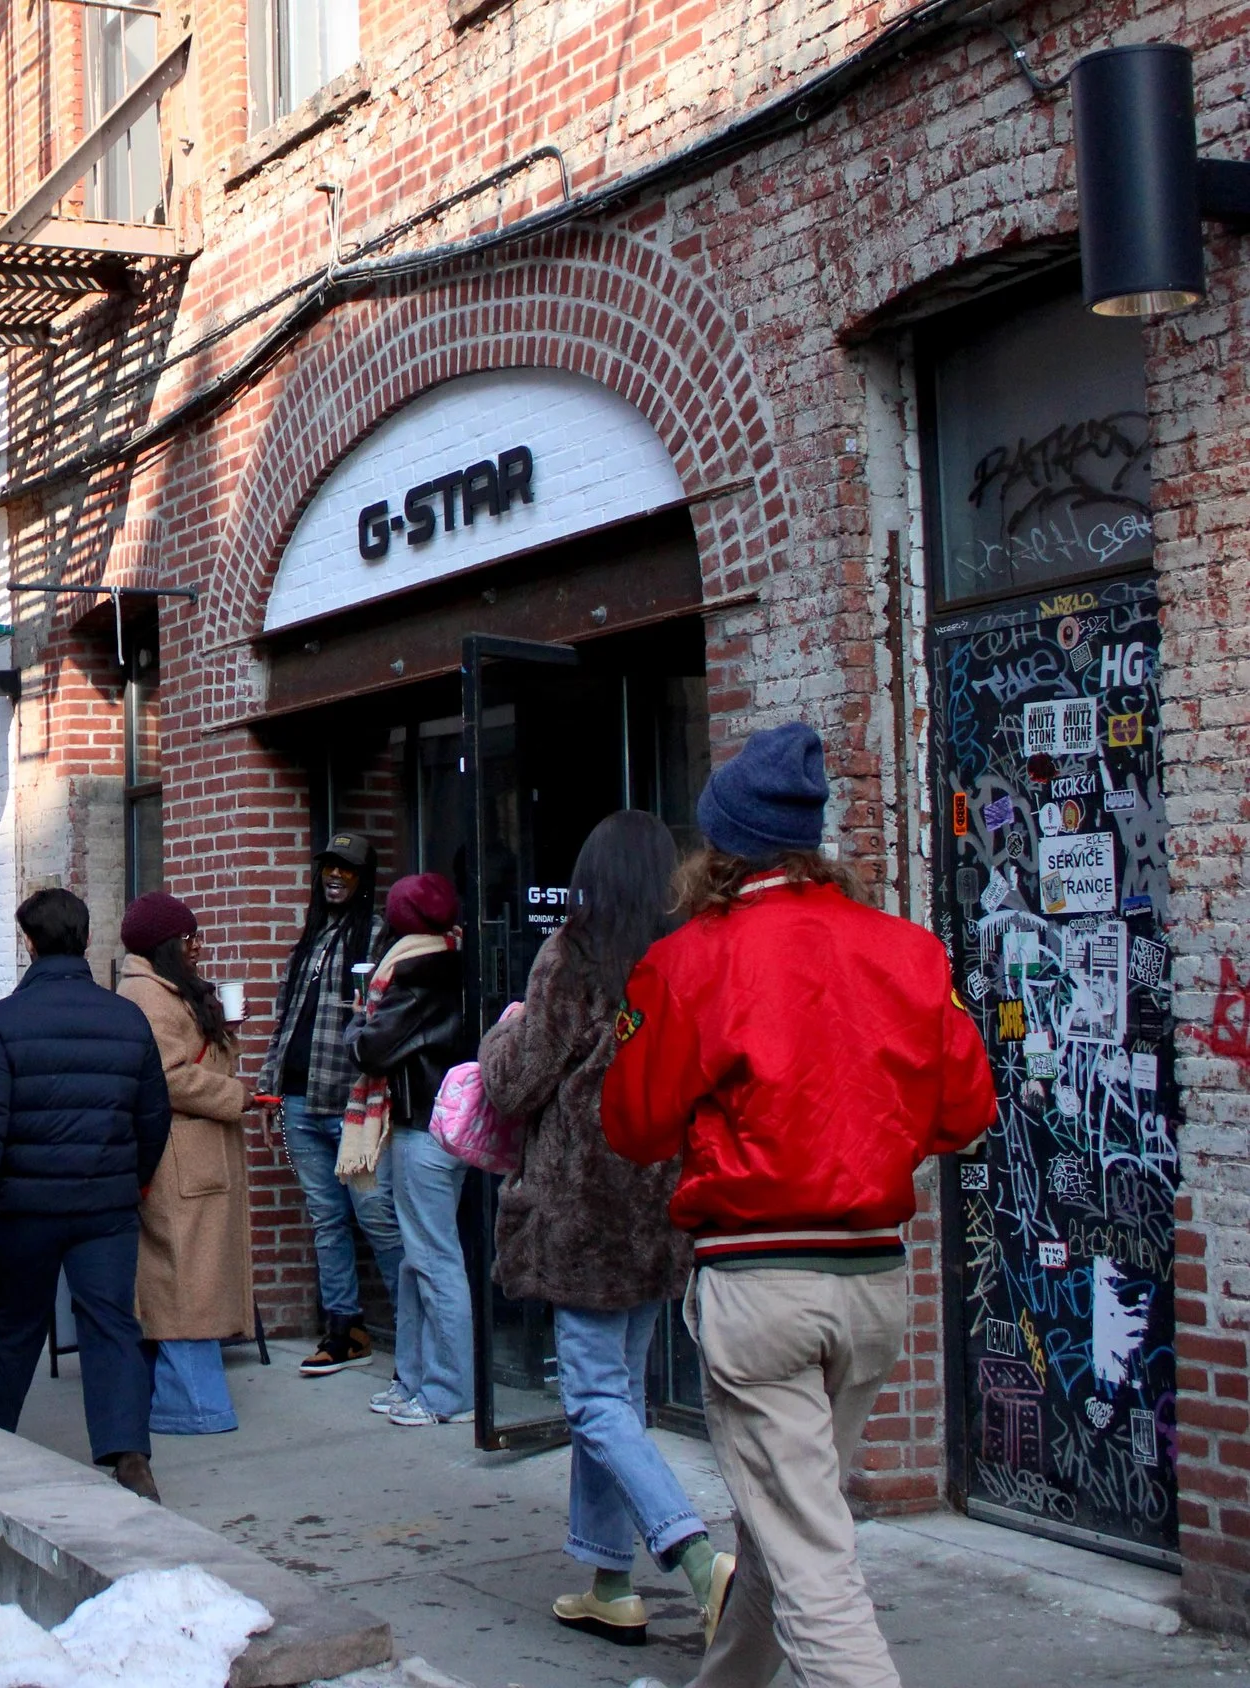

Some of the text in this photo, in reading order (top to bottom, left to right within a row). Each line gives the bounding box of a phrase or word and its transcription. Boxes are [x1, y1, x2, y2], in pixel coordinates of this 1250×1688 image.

[358, 445, 534, 561] G-STAR
[1100, 641, 1144, 688] HG
[1028, 713, 1056, 730] MUTZ
[1063, 709, 1092, 727] MUTZ
[1047, 850, 1104, 869] SERVICE
[528, 914, 555, 923] MONDAY
